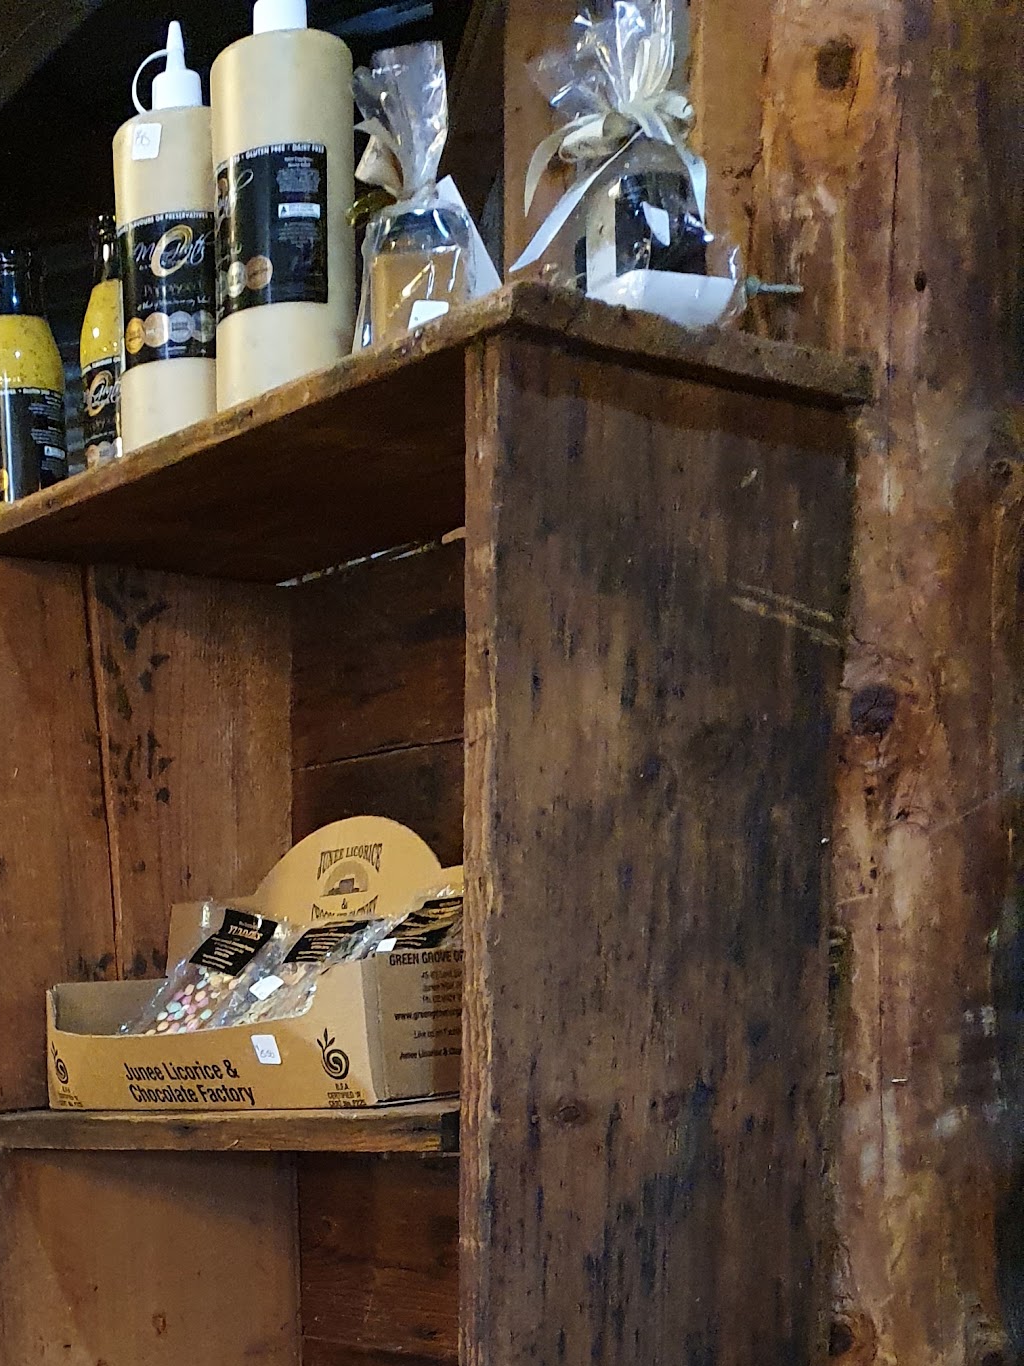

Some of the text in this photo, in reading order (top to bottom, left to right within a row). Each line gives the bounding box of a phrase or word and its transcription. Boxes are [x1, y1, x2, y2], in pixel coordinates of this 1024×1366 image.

[317, 843, 382, 880] JUNEE LICORICE
[389, 952, 419, 966] GREEN
[124, 1059, 239, 1081] Junee Licorice &
[129, 1083, 256, 1106] Chocolate Factory
